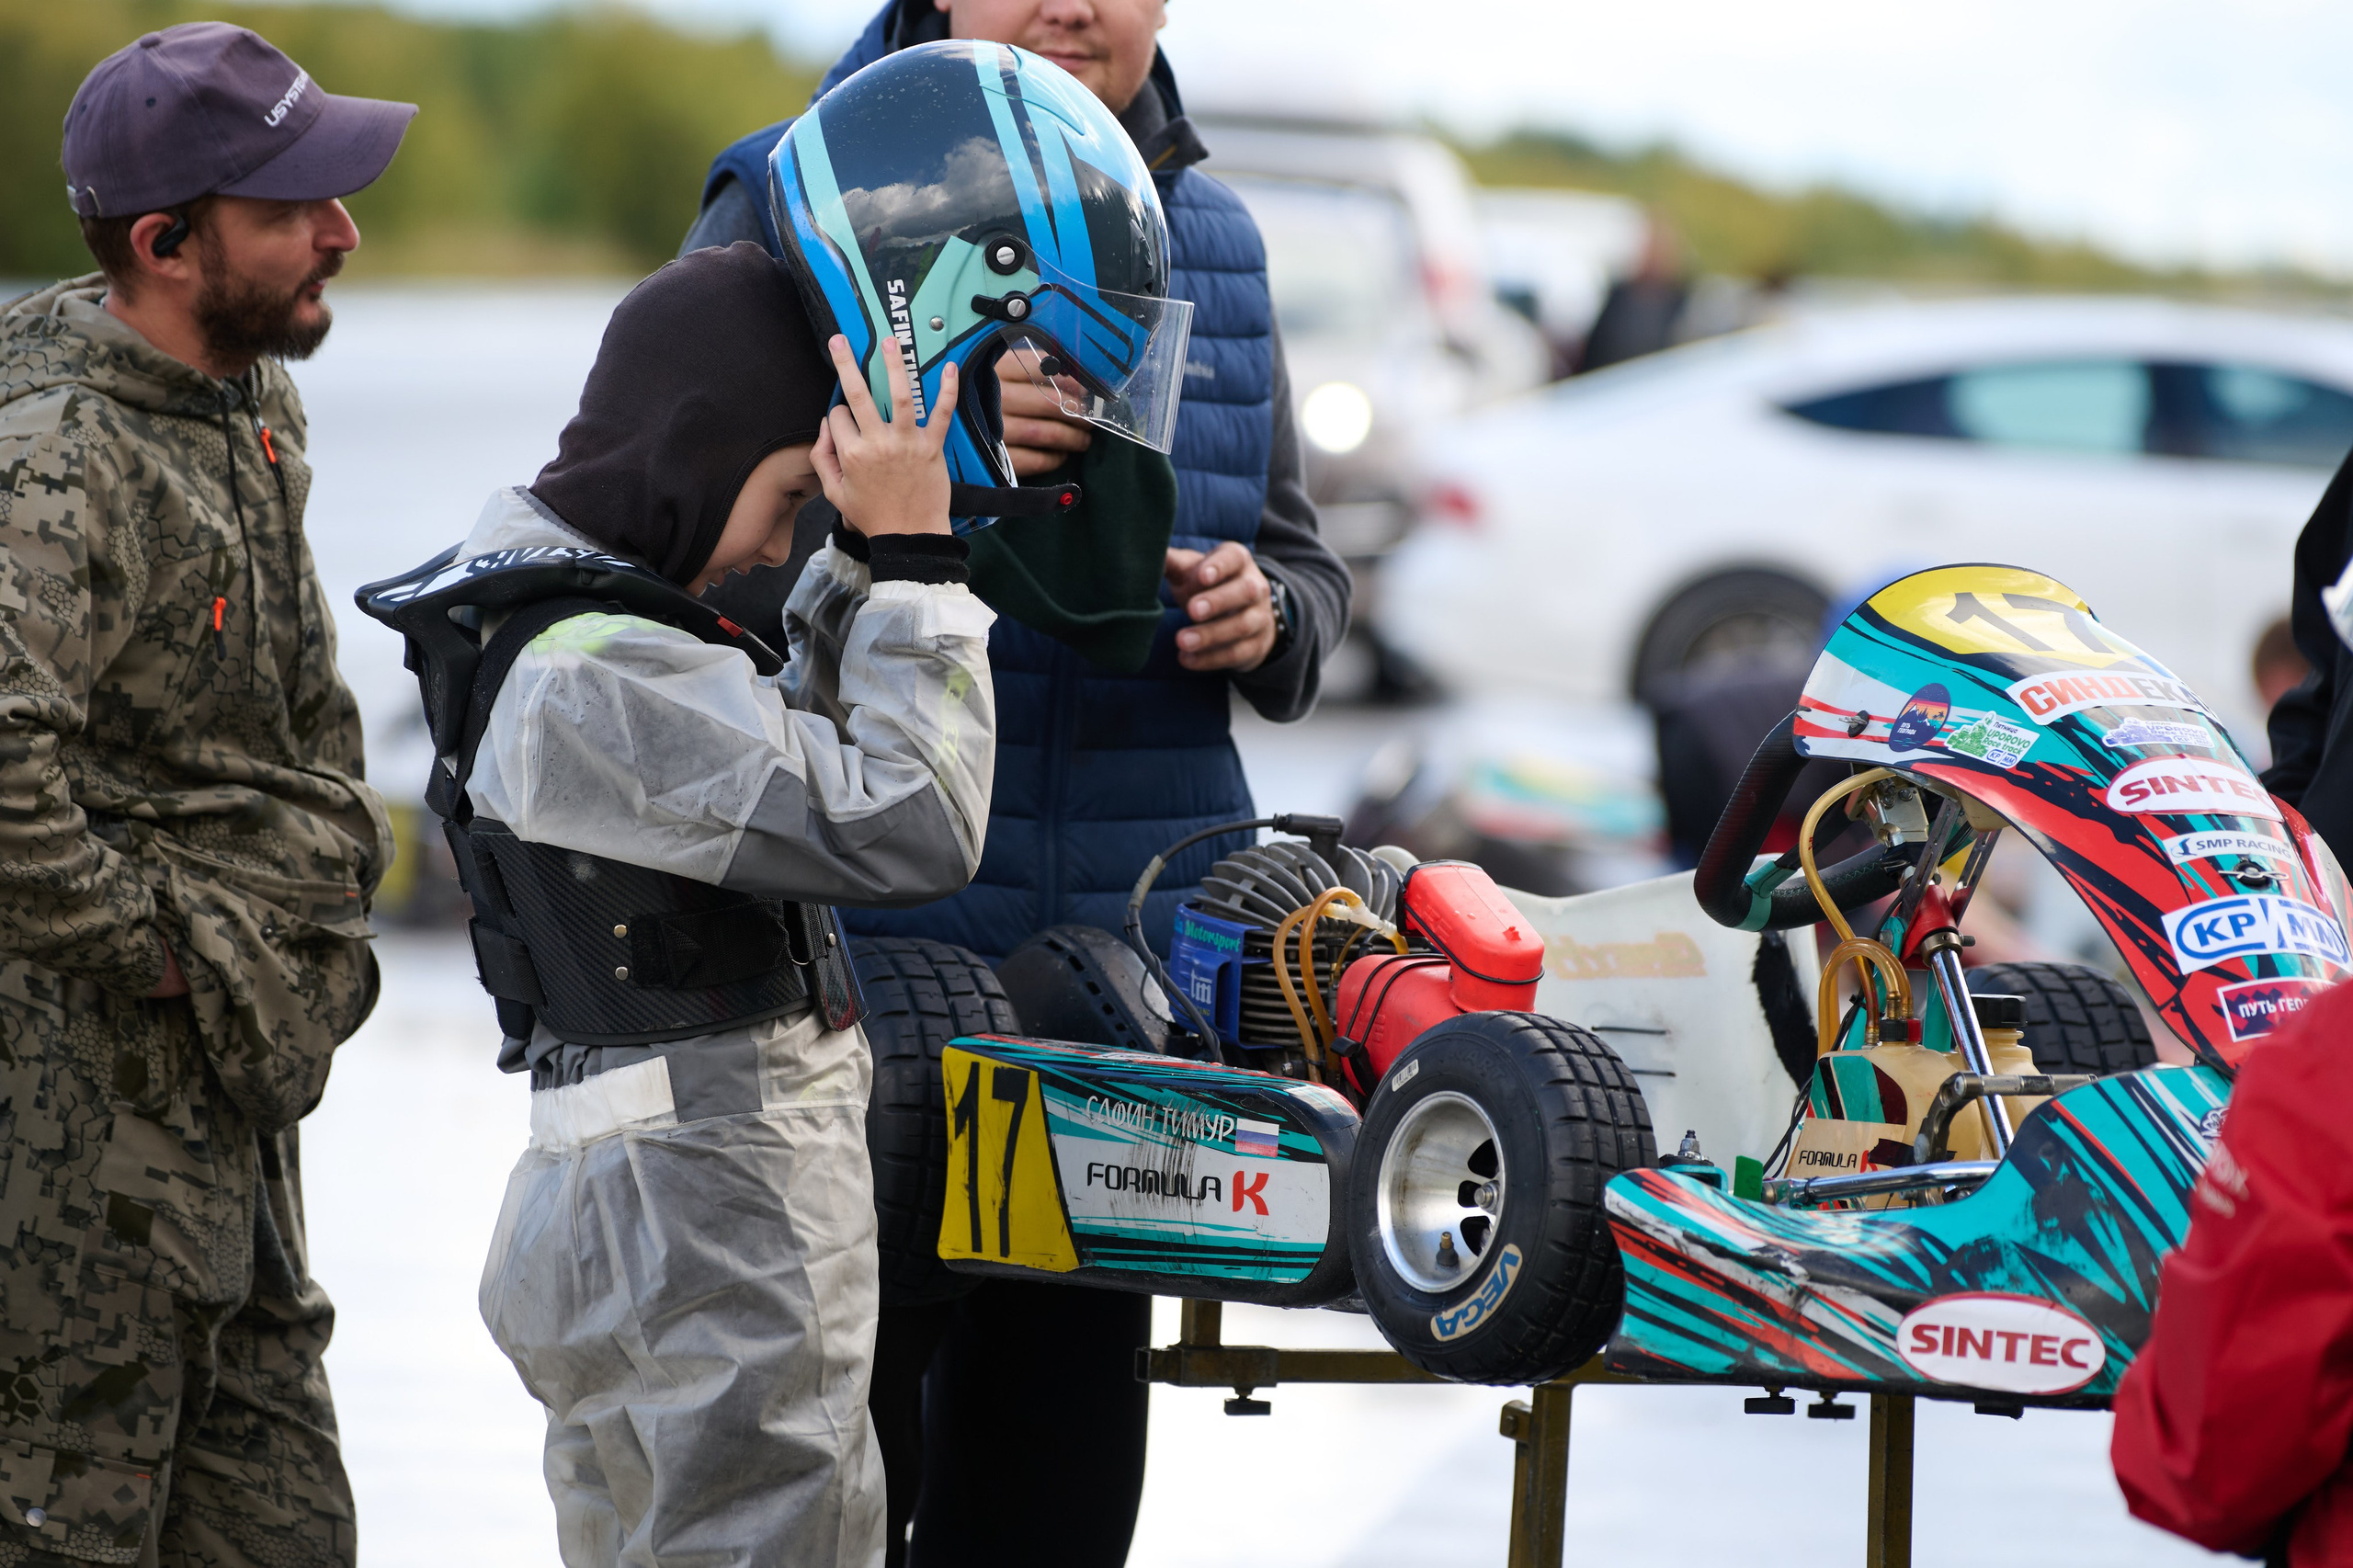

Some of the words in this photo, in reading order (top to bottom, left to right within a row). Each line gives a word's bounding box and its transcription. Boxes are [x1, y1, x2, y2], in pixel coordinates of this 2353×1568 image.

[887, 278, 914, 346] SAFIN
[1945, 591, 2116, 653] 17
[1982, 737, 2001, 748] Race
[2002, 743, 2024, 756] track
[1986, 729, 2031, 749] UPOROVO
[2146, 724, 2208, 736] UPOROVO
[2120, 775, 2278, 814] SINTEC
[2196, 838, 2233, 851] SMP
[2236, 838, 2292, 859] RACING
[1185, 919, 1241, 952] Motorsport
[2238, 999, 2278, 1018] ПУТЬ
[1086, 1095, 1157, 1132] САФИН
[1162, 1106, 1235, 1142] ТИМУР
[955, 1062, 1030, 1258] 17
[1798, 1150, 1858, 1169] FORMULA
[1086, 1162, 1222, 1203] FORMULA
[1232, 1170, 1269, 1216] K
[1435, 1251, 1520, 1337] VEGA
[1910, 1324, 2091, 1369] SINTEC
